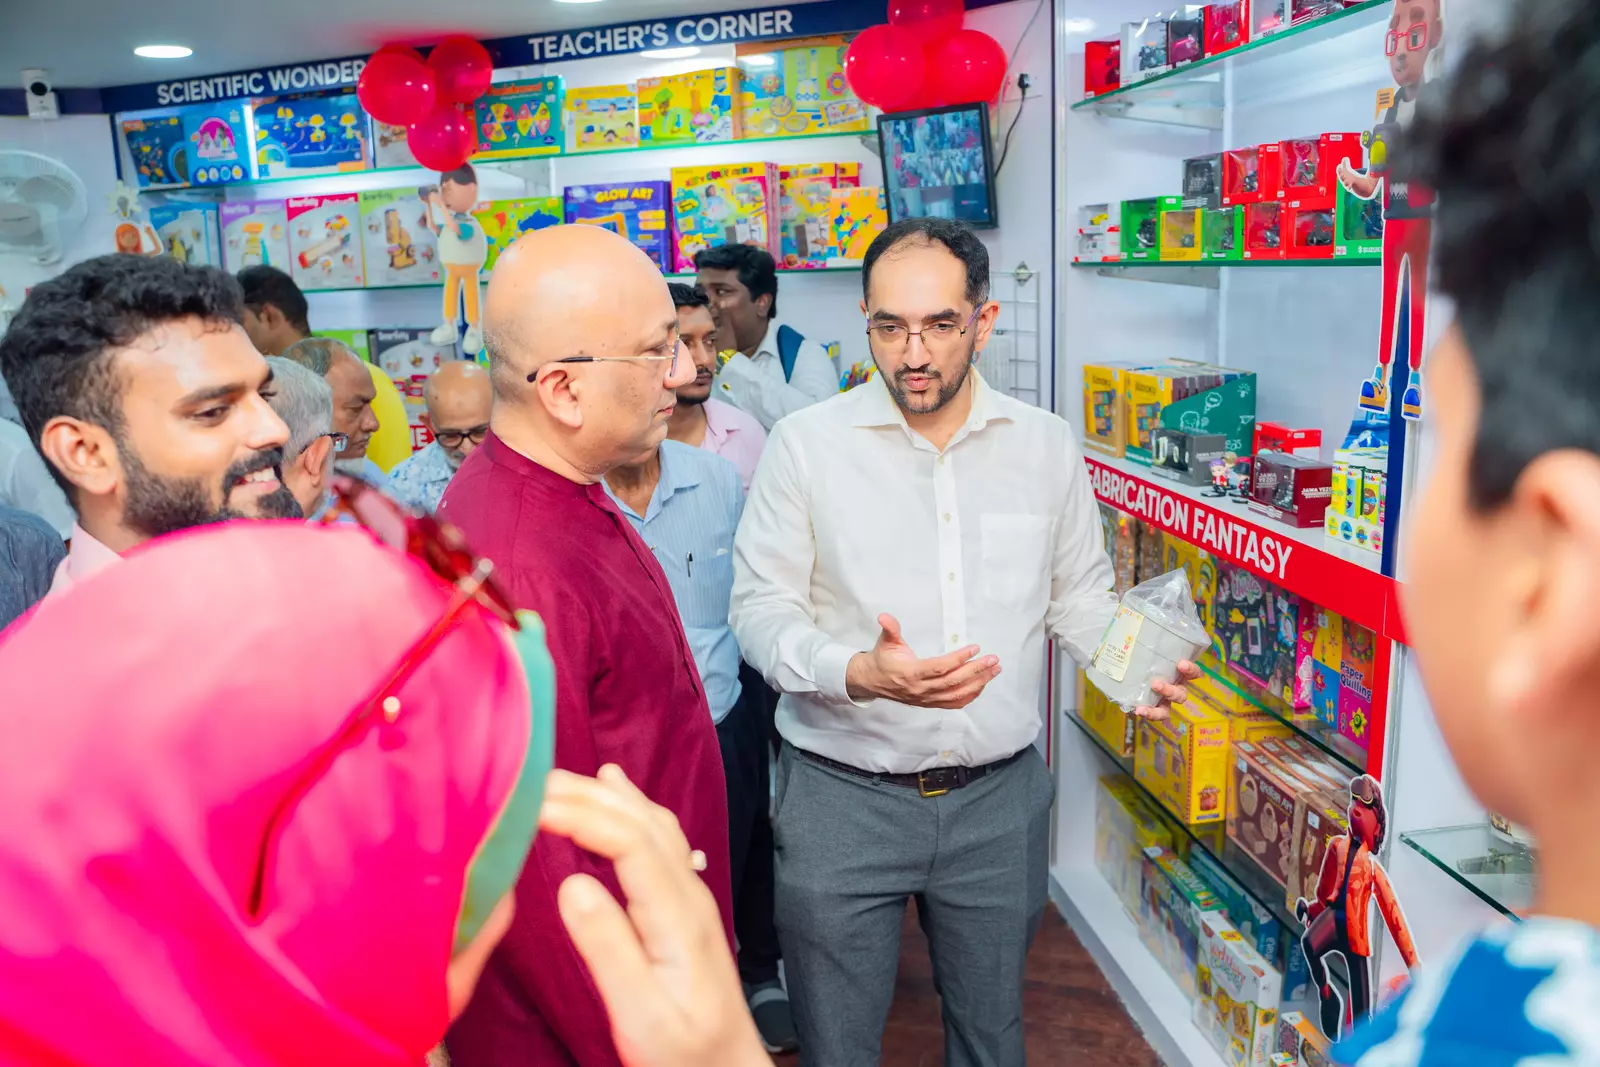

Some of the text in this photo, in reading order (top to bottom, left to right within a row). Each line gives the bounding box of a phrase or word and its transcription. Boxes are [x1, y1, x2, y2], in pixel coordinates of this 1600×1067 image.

[528, 10, 793, 60] TEACHER'S CORNER
[156, 73, 264, 105] SCIENTIFIC
[1192, 507, 1293, 579] FANTASY
[1340, 660, 1364, 681] Paper
[1340, 673, 1372, 703] Quilling
